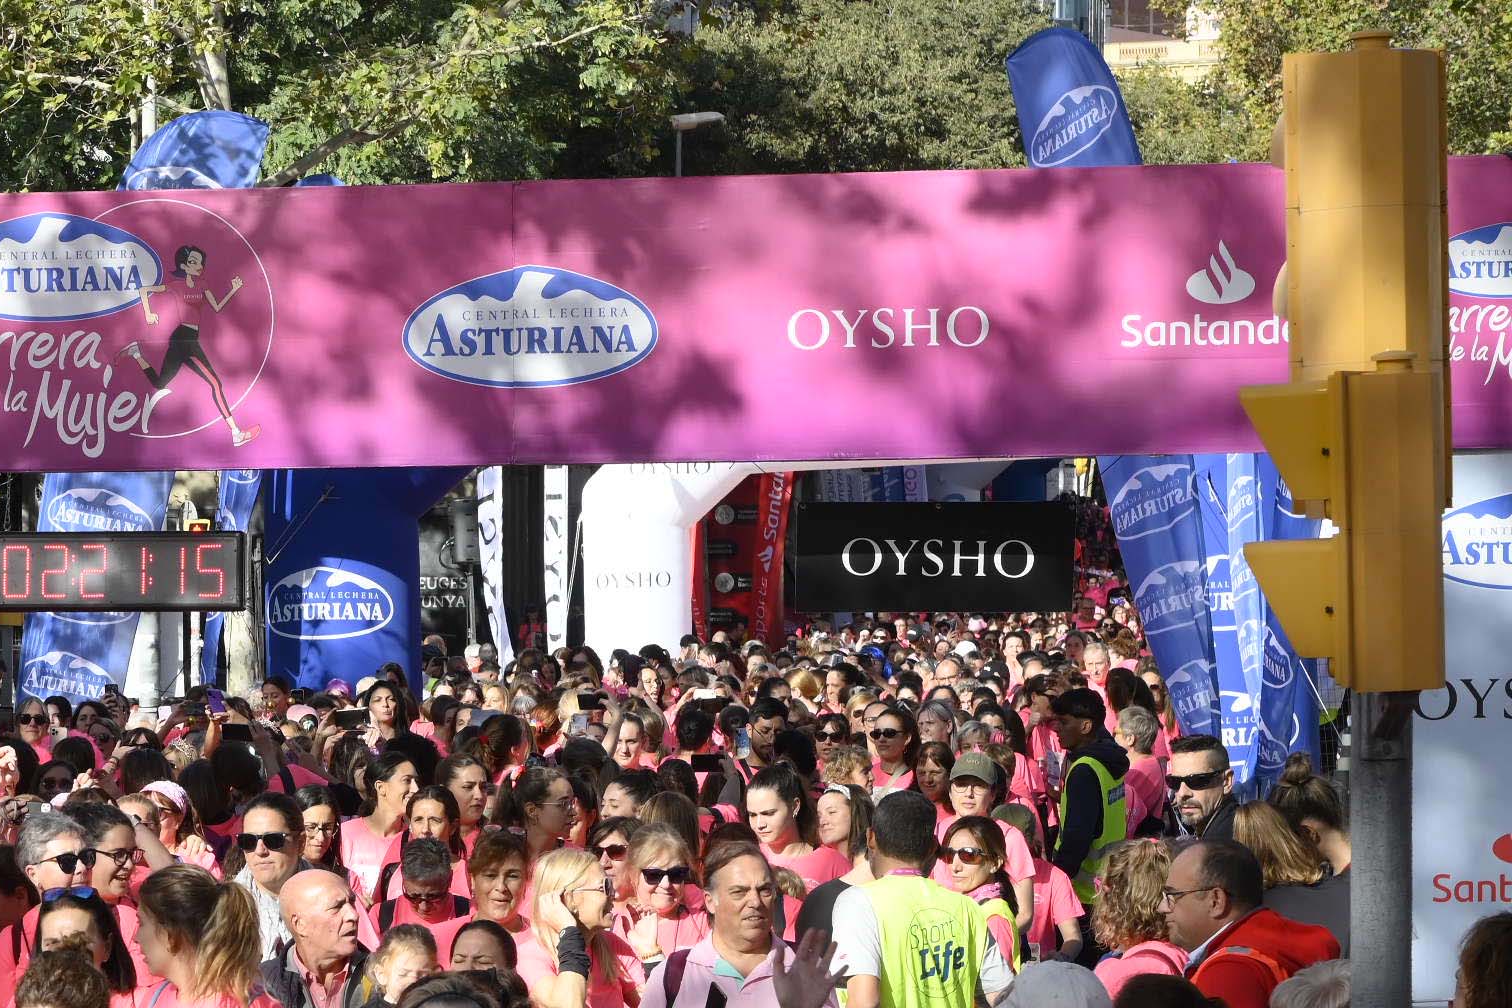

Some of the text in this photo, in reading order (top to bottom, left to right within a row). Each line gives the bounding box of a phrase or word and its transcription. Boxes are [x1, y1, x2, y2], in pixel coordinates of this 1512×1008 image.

[65, 248, 138, 261] LECHERA
[1448, 257, 1512, 280] ASTUR
[462, 306, 629, 322] CENTRAL LECHERA
[787, 306, 990, 351] OYSHO
[424, 313, 638, 358] ASTURIANA
[1120, 313, 1289, 348] Santand
[1470, 335, 1489, 361] la
[4, 374, 27, 413] la
[24, 362, 174, 458] Mujer
[53, 502, 144, 532] ASTURIANA
[2, 544, 226, 600] 02:21:15
[841, 537, 1036, 579] OYSHO
[285, 591, 380, 600] CENTRAL LECHERA
[596, 570, 672, 591] OYSHO
[271, 596, 385, 624] ASTURIANA
[911, 920, 956, 950] Sport
[920, 941, 965, 983] Life
